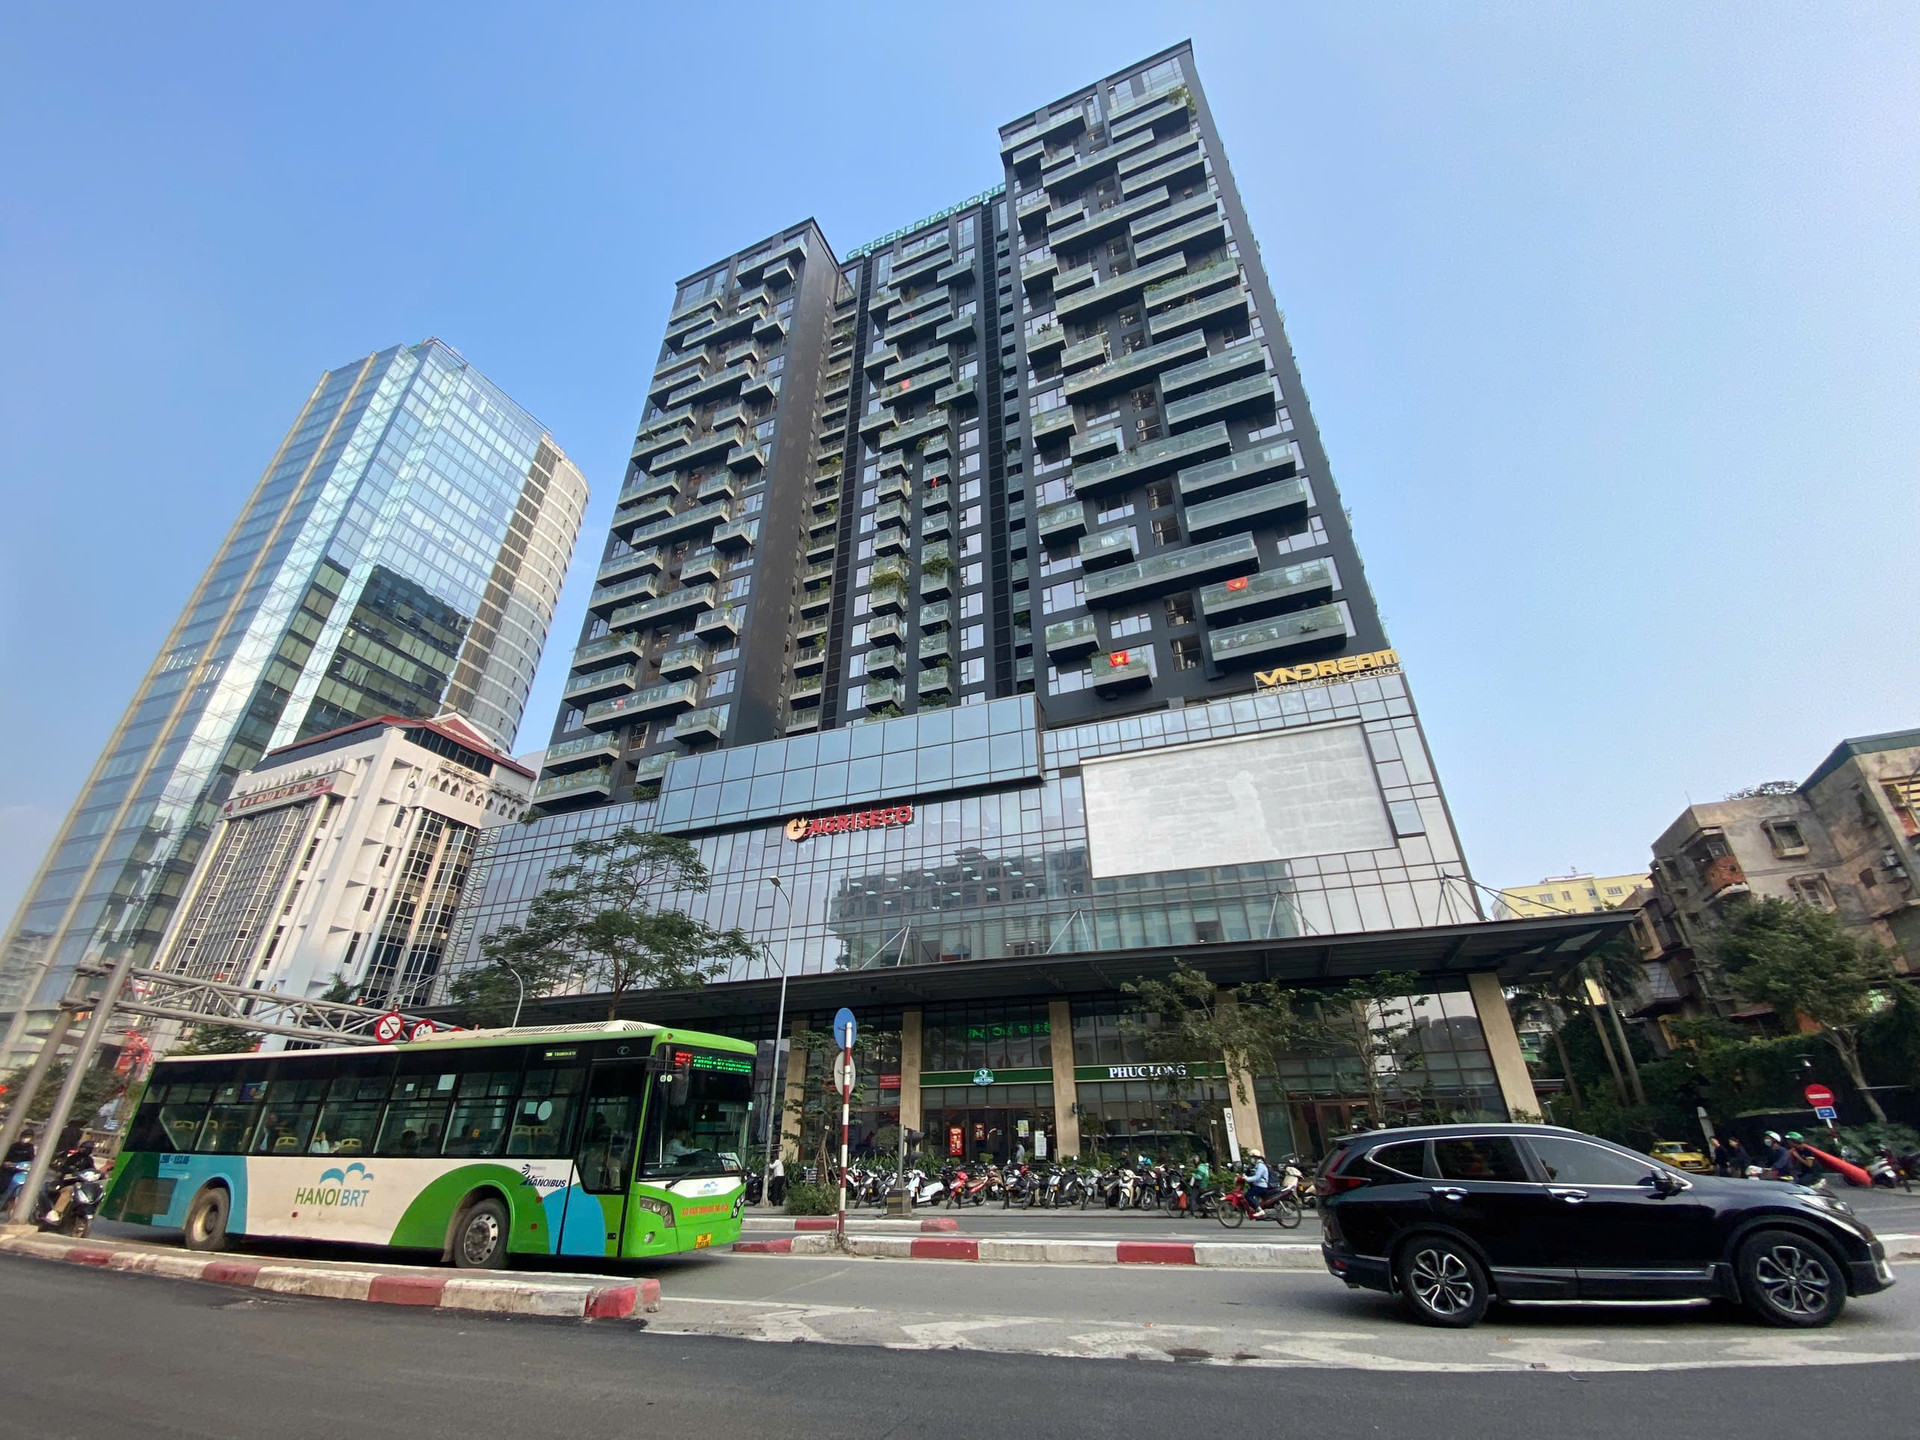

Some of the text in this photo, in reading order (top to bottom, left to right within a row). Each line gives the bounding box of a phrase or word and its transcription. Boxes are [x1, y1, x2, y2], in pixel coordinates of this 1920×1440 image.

[846, 226, 908, 261] GREEN
[806, 805, 913, 835] AGRISECO
[520, 1174, 567, 1188] HANOIBUS
